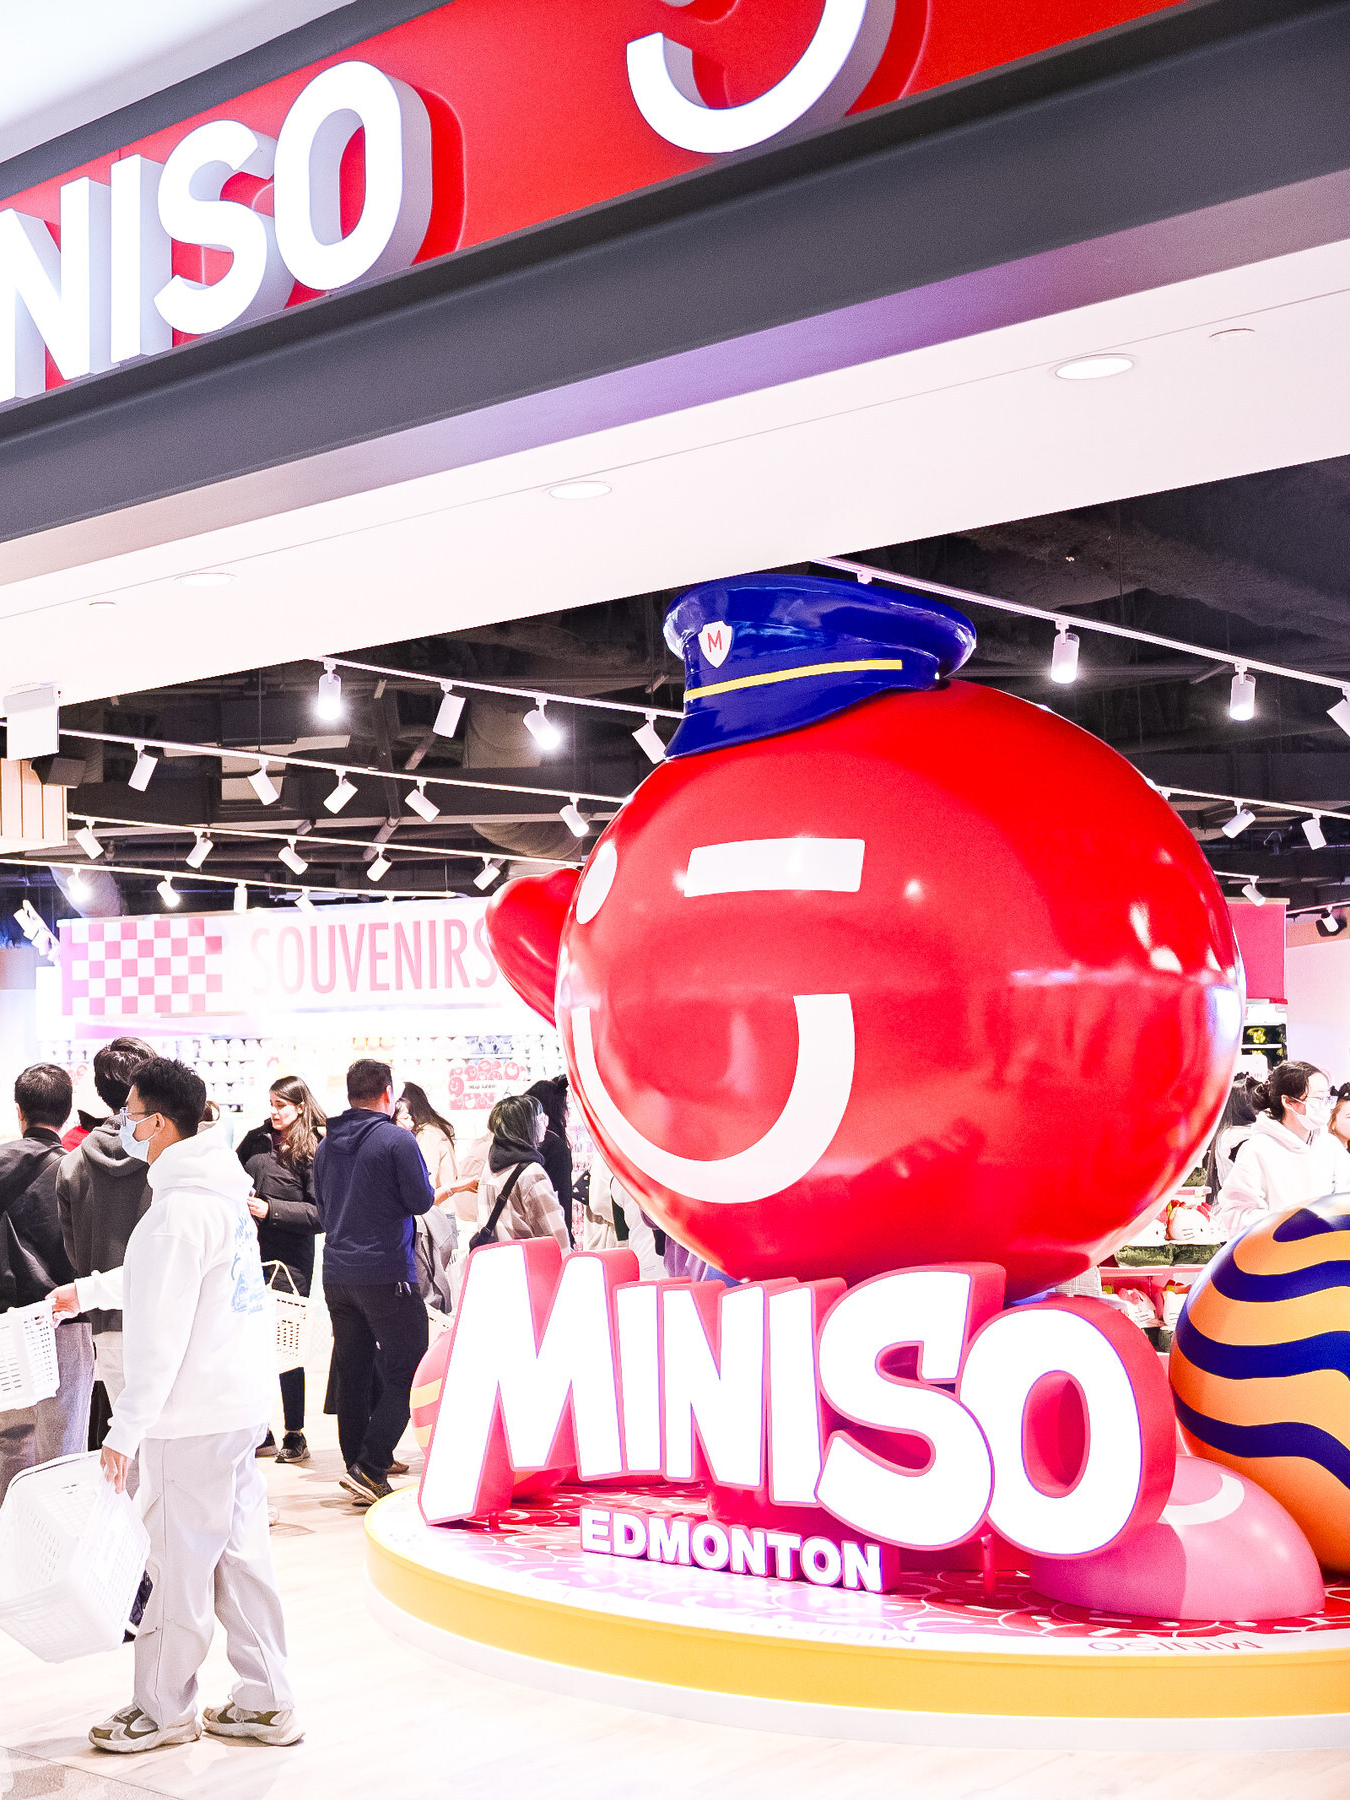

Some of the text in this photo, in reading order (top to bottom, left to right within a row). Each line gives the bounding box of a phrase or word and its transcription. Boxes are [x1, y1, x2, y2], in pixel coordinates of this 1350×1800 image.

[707, 629, 723, 653] M
[250, 917, 499, 996] SOUVENIRS
[418, 1237, 1150, 1560] MINISO
[580, 1505, 888, 1595] EDMONTON
[1087, 1639, 1264, 1652] MINISO
